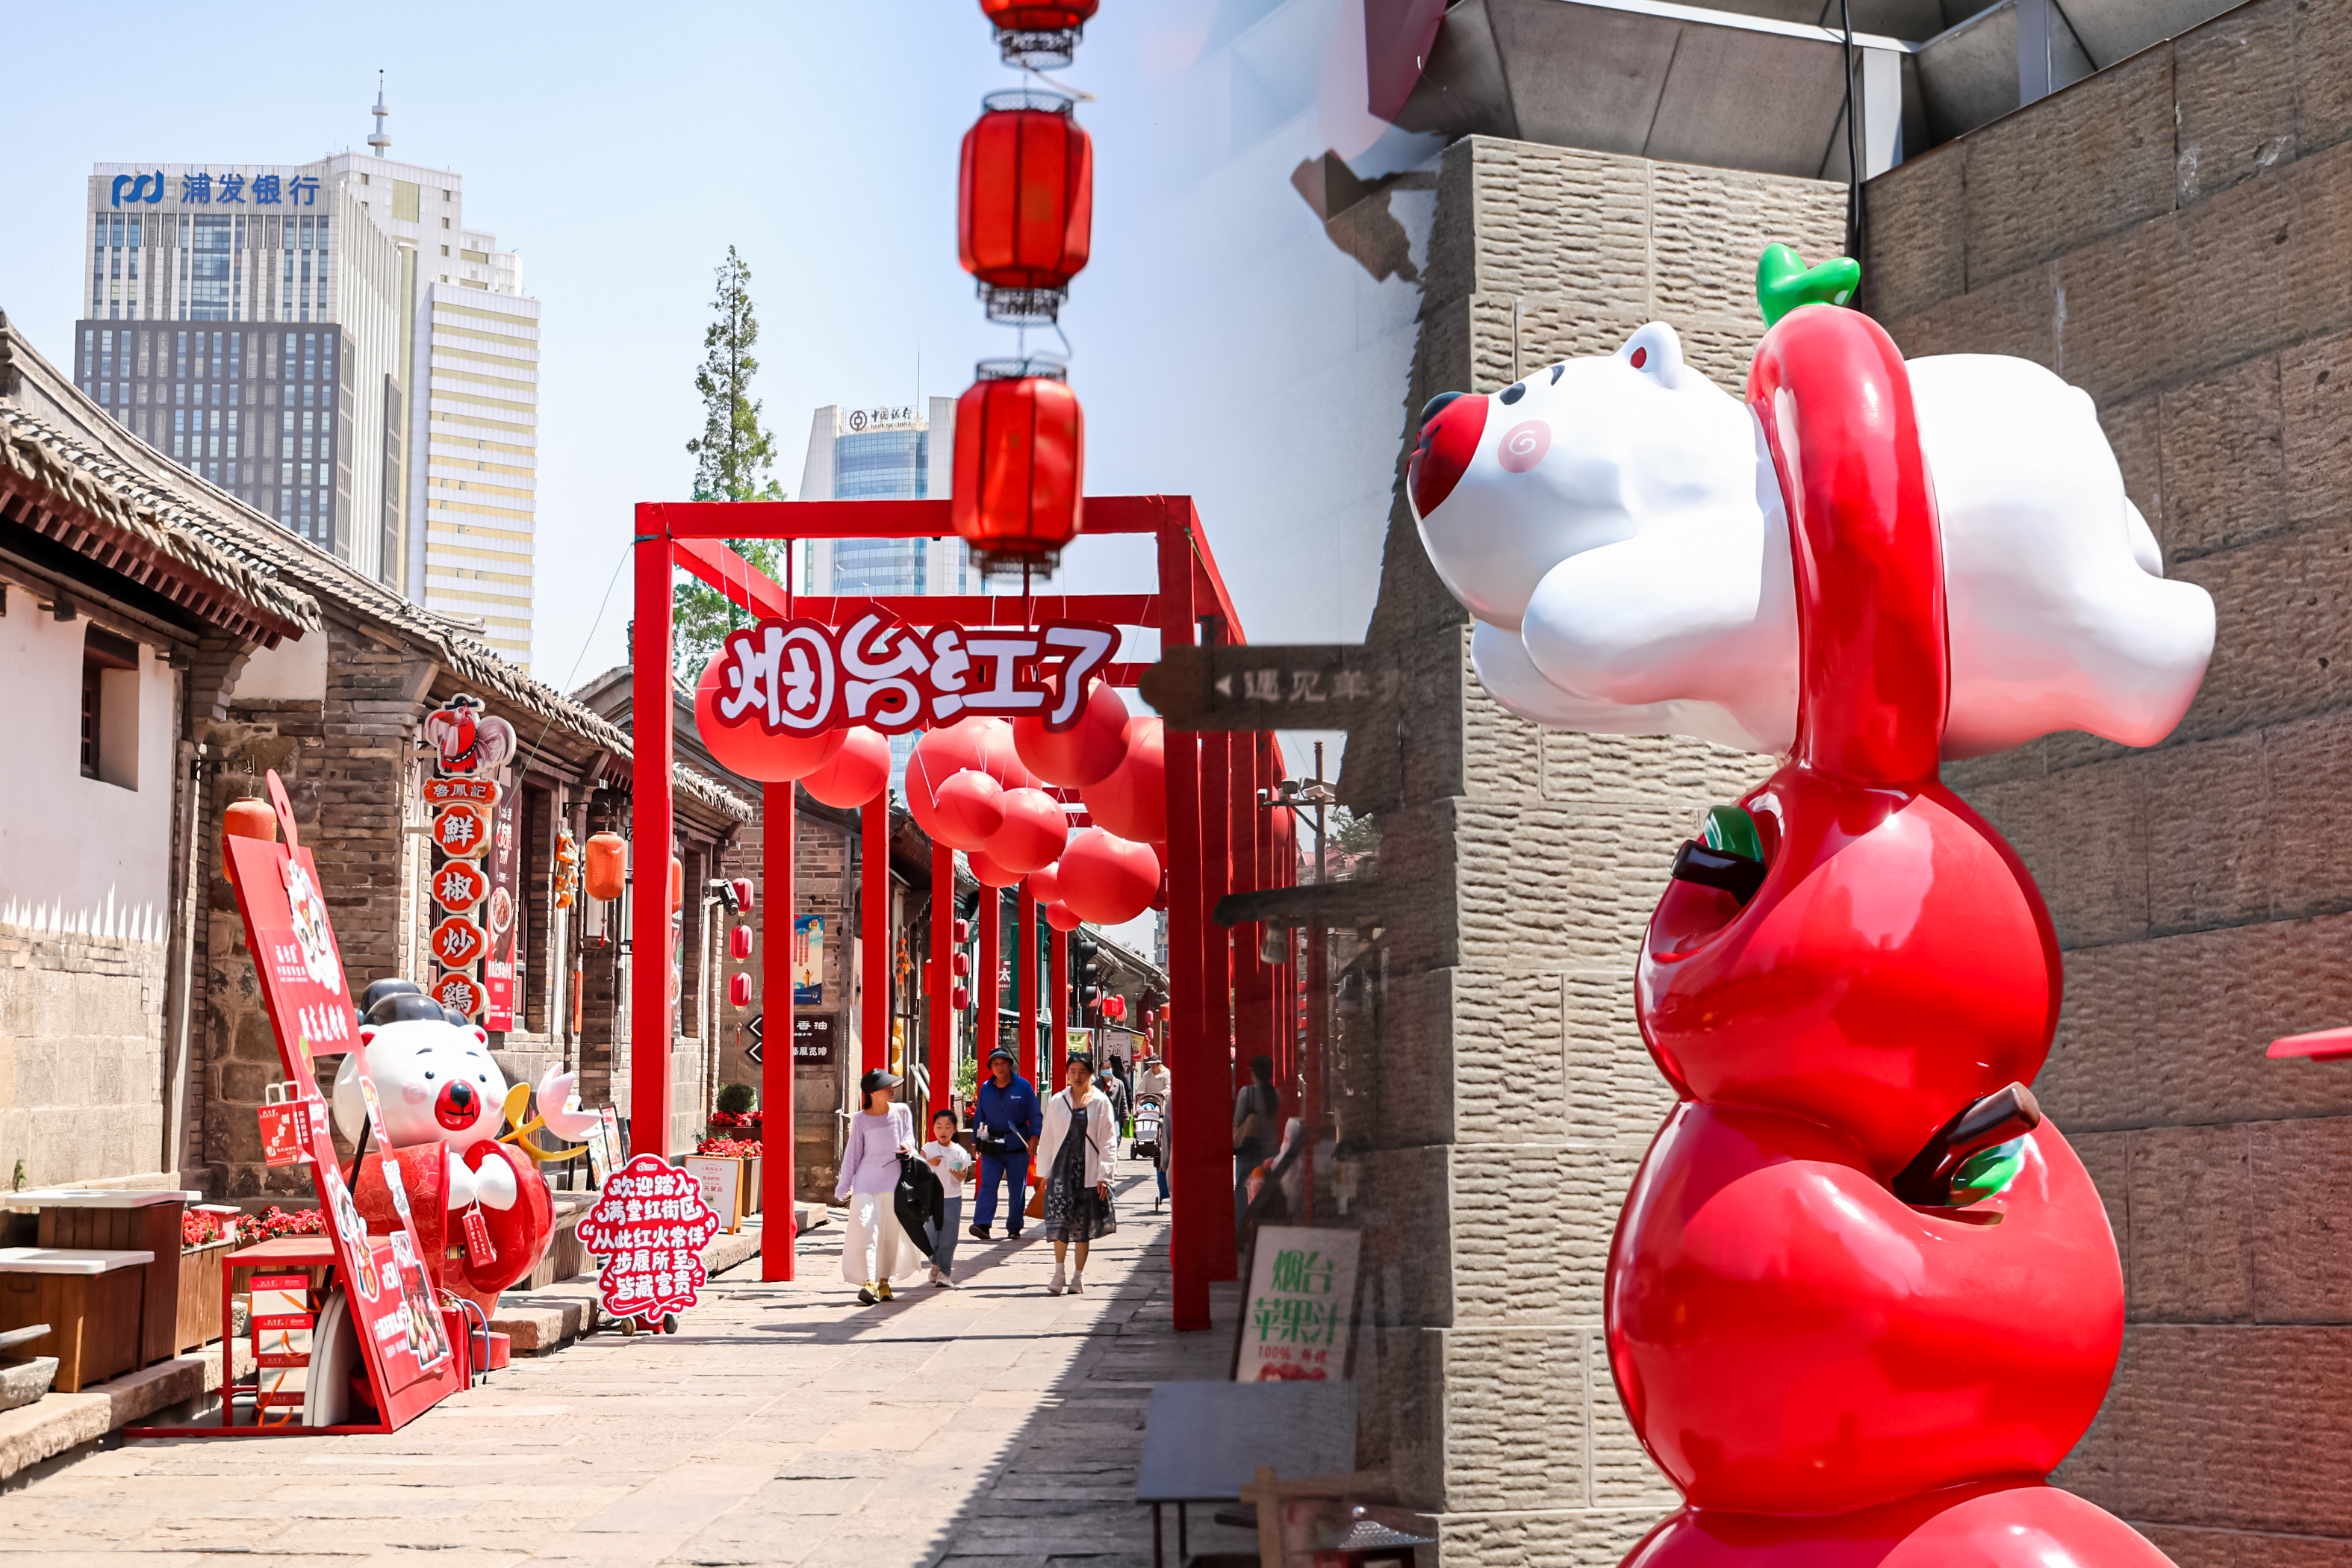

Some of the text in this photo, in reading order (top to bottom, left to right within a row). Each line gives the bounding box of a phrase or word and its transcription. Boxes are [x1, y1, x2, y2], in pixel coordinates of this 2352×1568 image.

[181, 172, 320, 205] 浦发银行
[719, 614, 1113, 729] 烟台红了
[433, 783, 486, 799] 魯鳳記
[609, 1173, 694, 1198] 欢迎踏入
[597, 1196, 703, 1225] 满堂红街区
[612, 1249, 697, 1275] 步履所至
[1271, 1249, 1334, 1295] 烟台
[616, 1269, 691, 1301] 皆藏富贵
[1251, 1297, 1344, 1346] 苹果汁
[1259, 1345, 1291, 1360] 100%
